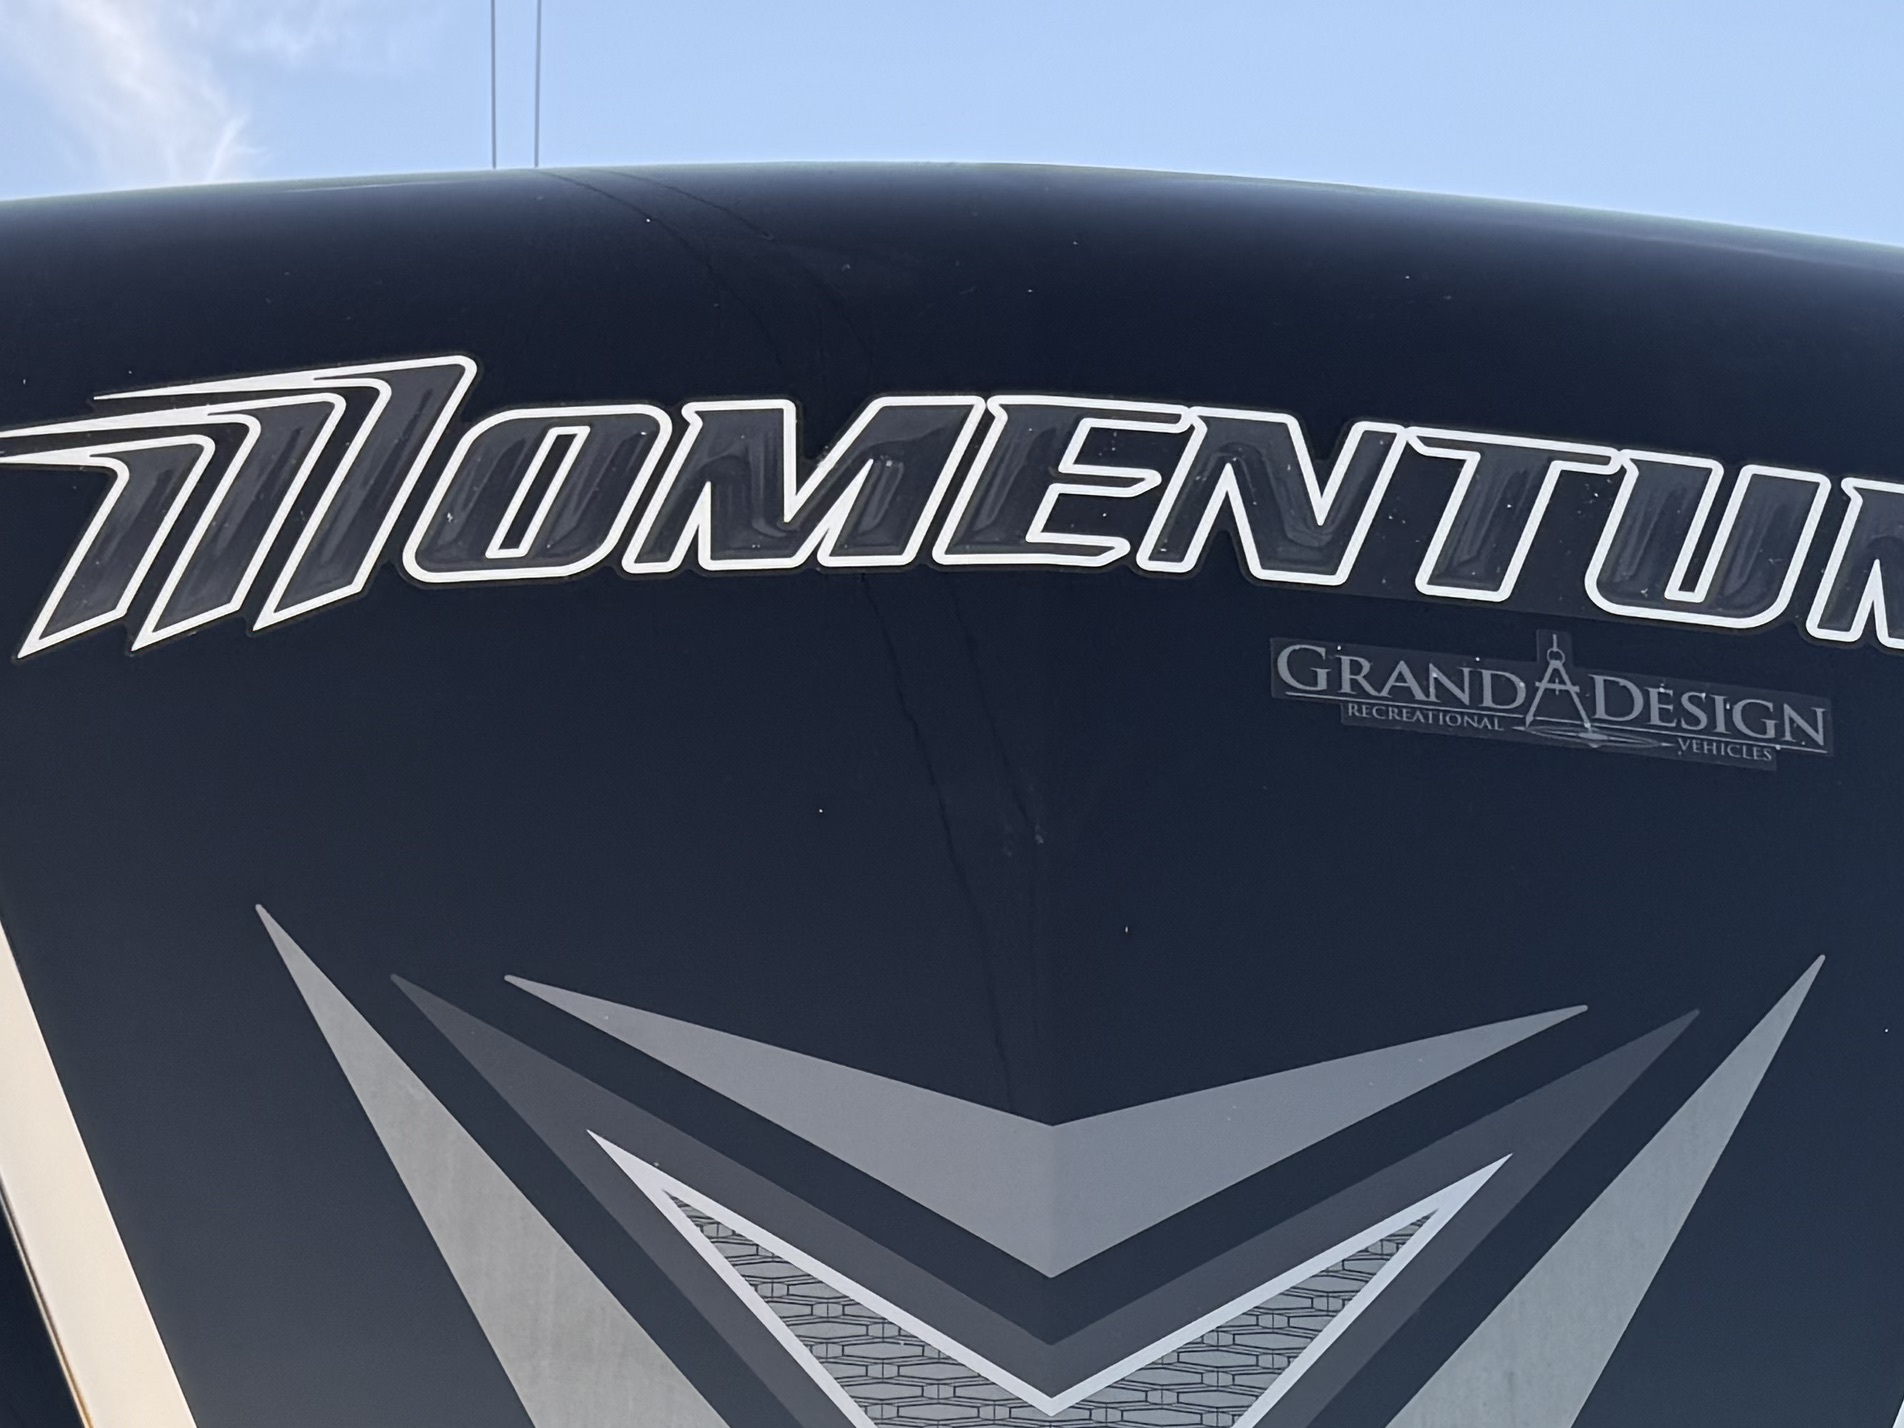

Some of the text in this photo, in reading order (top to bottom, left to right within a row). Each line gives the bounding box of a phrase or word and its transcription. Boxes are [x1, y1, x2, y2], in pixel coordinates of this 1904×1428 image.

[1275, 644, 1826, 747] GRAND DESIGN
[1346, 702, 1774, 762] RECREATIONAL VEHICLES
